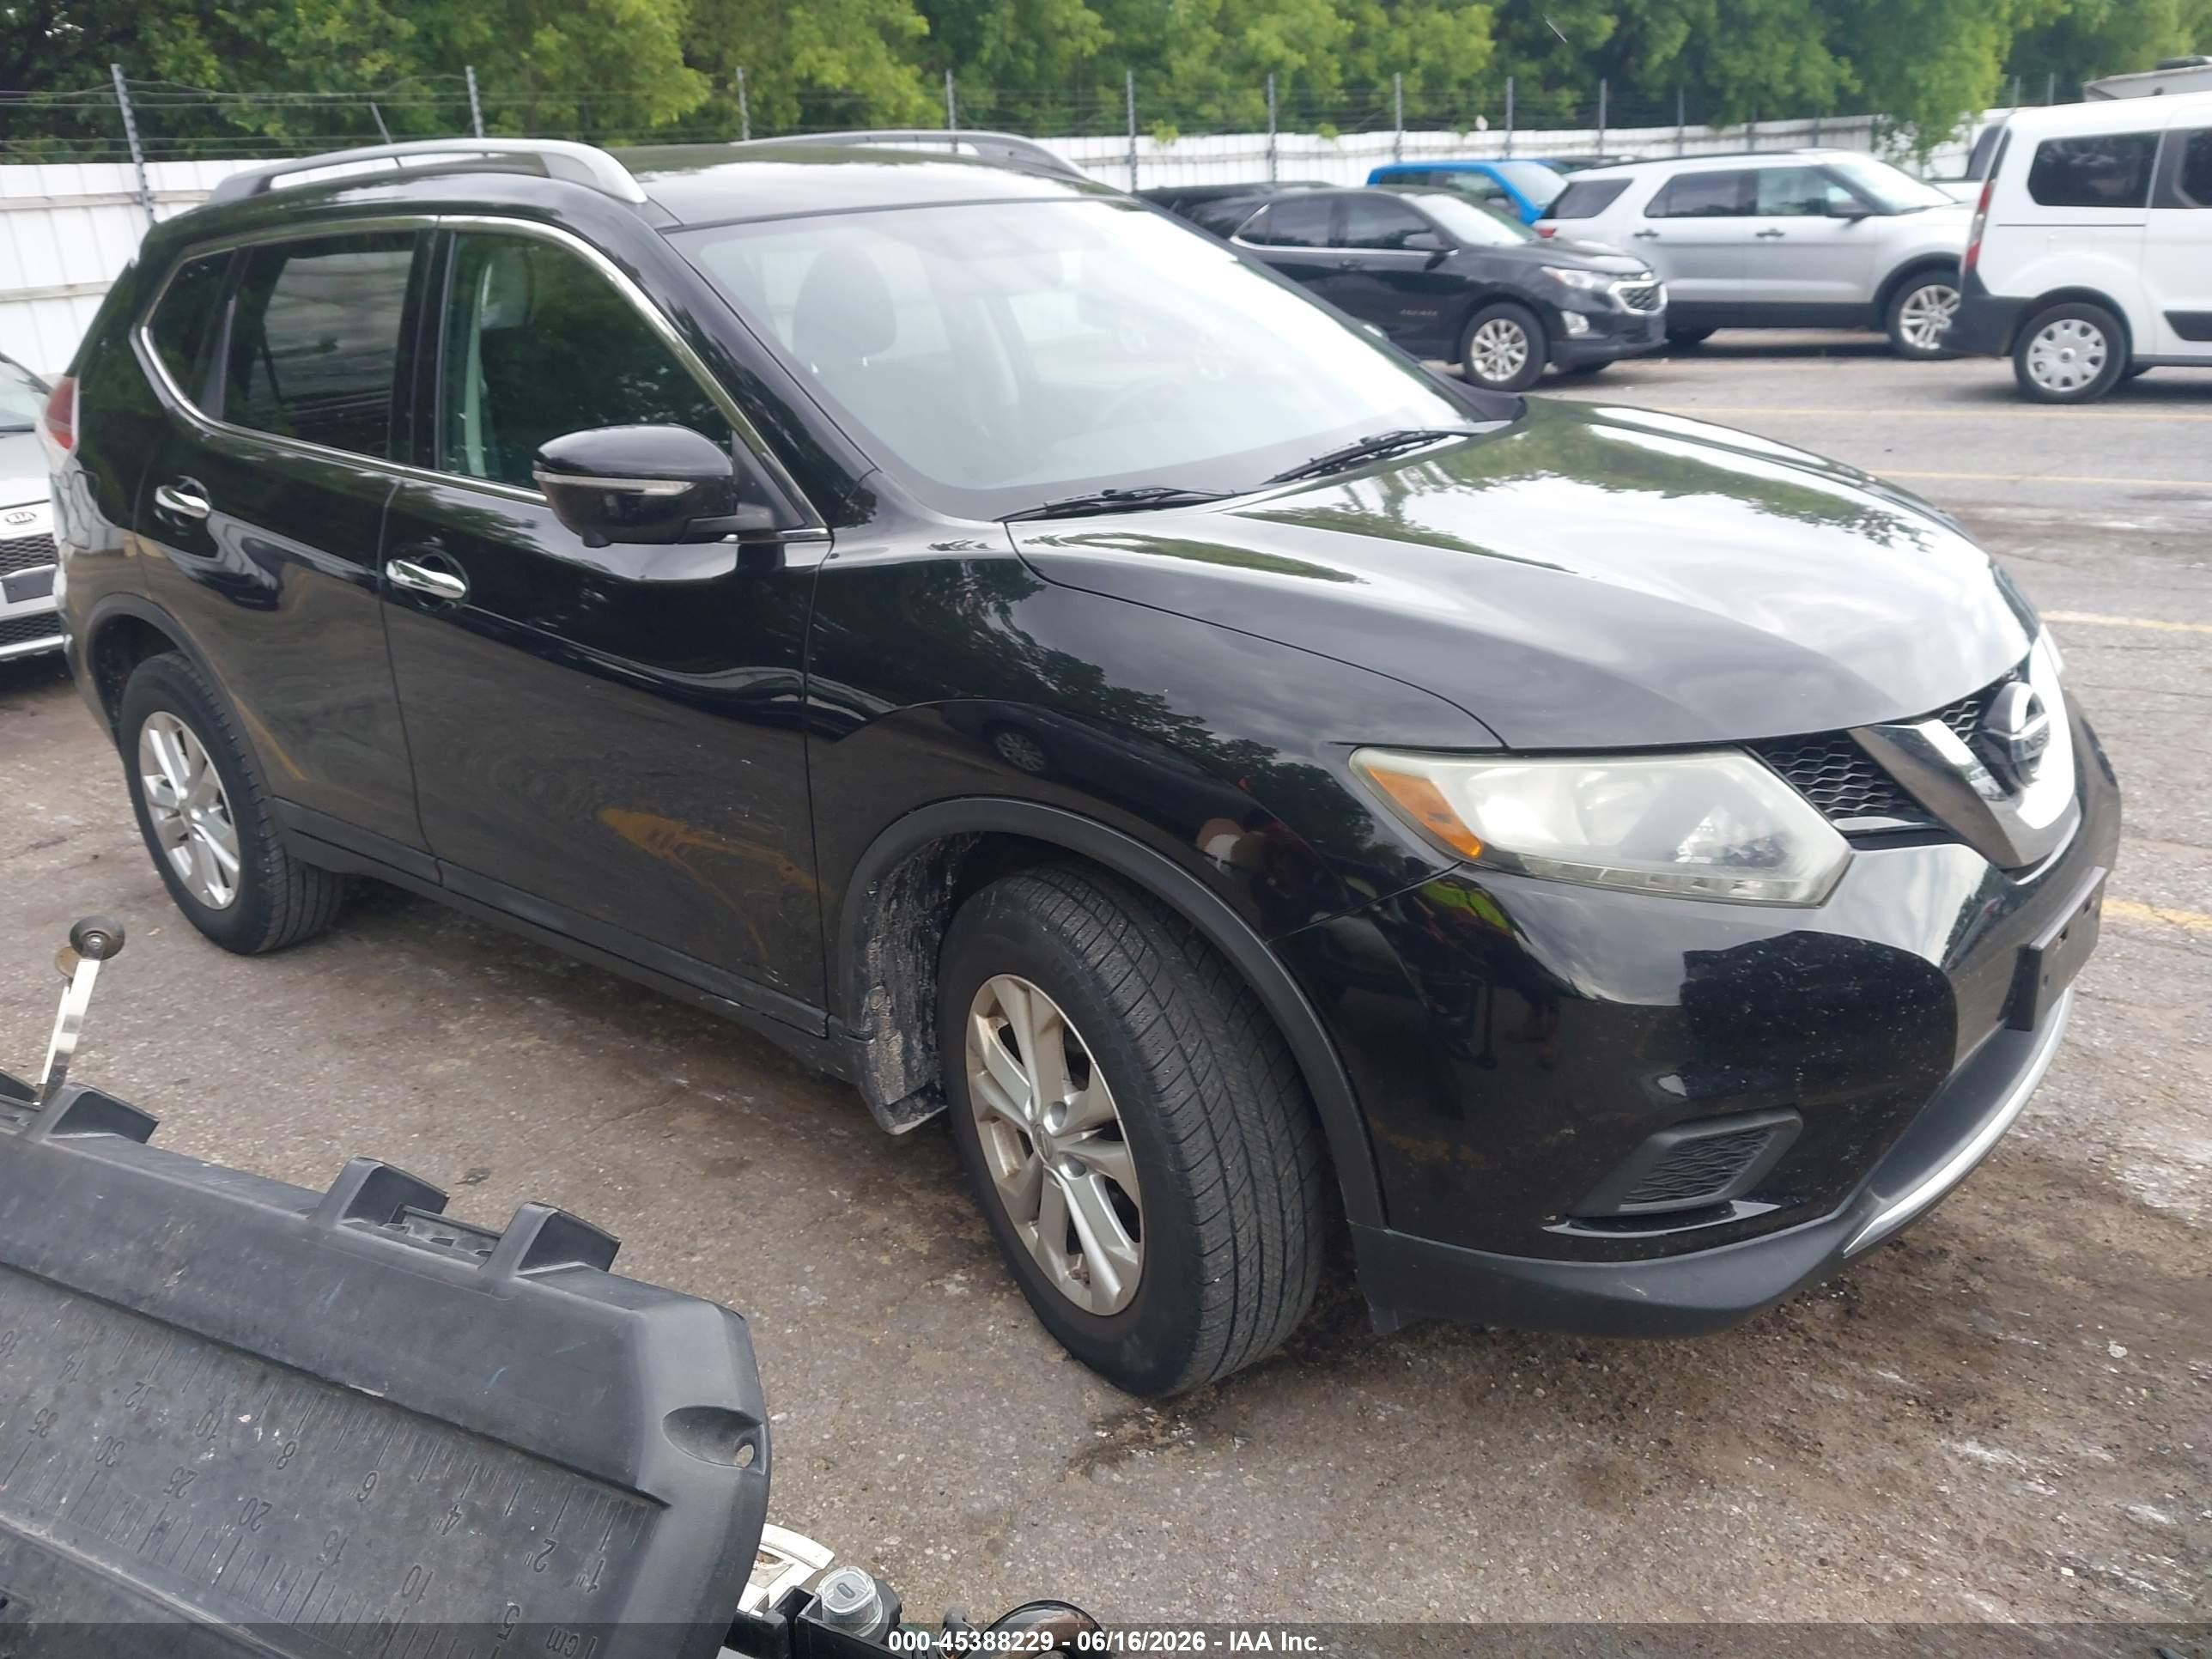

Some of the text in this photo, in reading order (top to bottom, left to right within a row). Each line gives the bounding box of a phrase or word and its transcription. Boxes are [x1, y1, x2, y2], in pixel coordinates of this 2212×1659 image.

[163, 1465, 198, 1499] 25
[239, 1497, 273, 1533] 20
[402, 1565, 434, 1603] 10
[496, 1605, 520, 1641] 5
